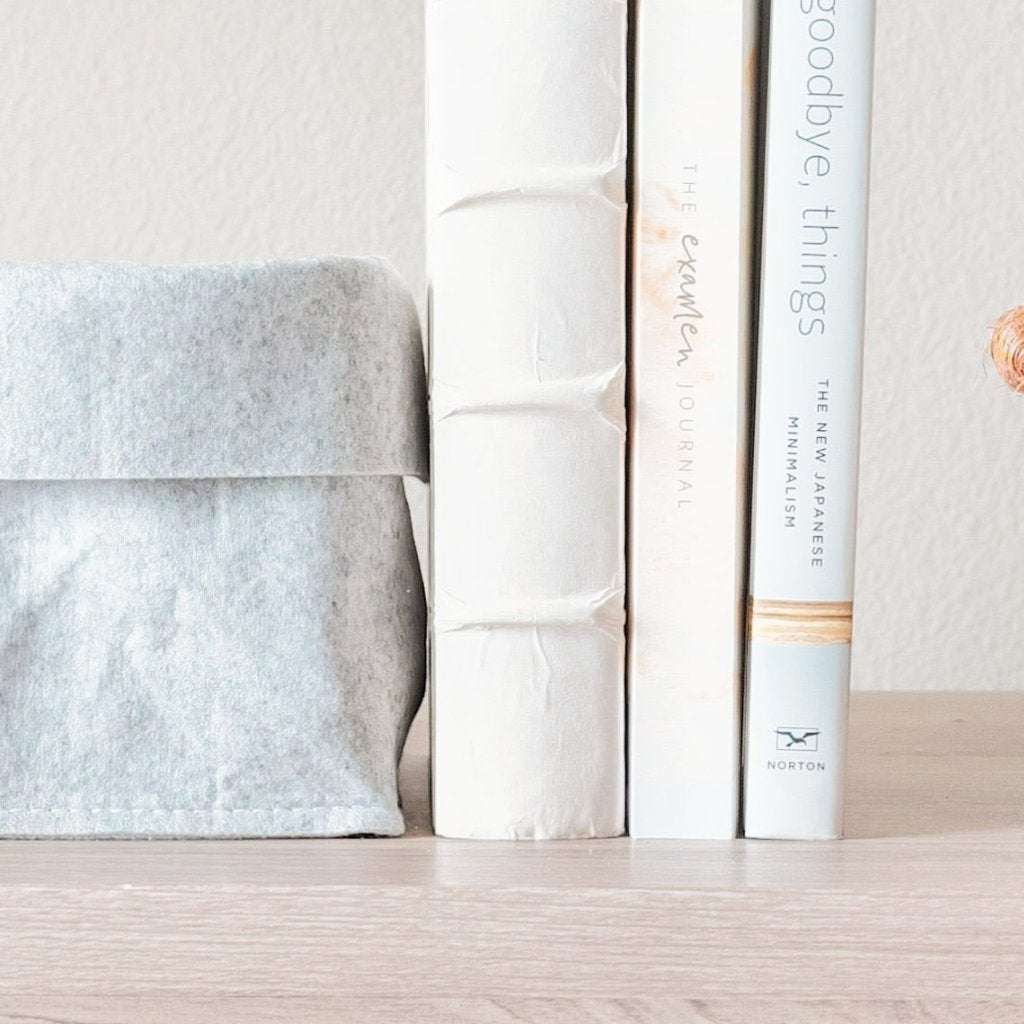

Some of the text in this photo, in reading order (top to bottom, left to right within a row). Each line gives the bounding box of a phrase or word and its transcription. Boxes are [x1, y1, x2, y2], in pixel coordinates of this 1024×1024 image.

[789, 205, 839, 336] things
[673, 164, 704, 509] THE examen JOURNAL
[784, 416, 800, 528] MINIMALISM
[811, 379, 829, 568] THE NEW JAPANESE
[767, 760, 825, 771] NORTON
